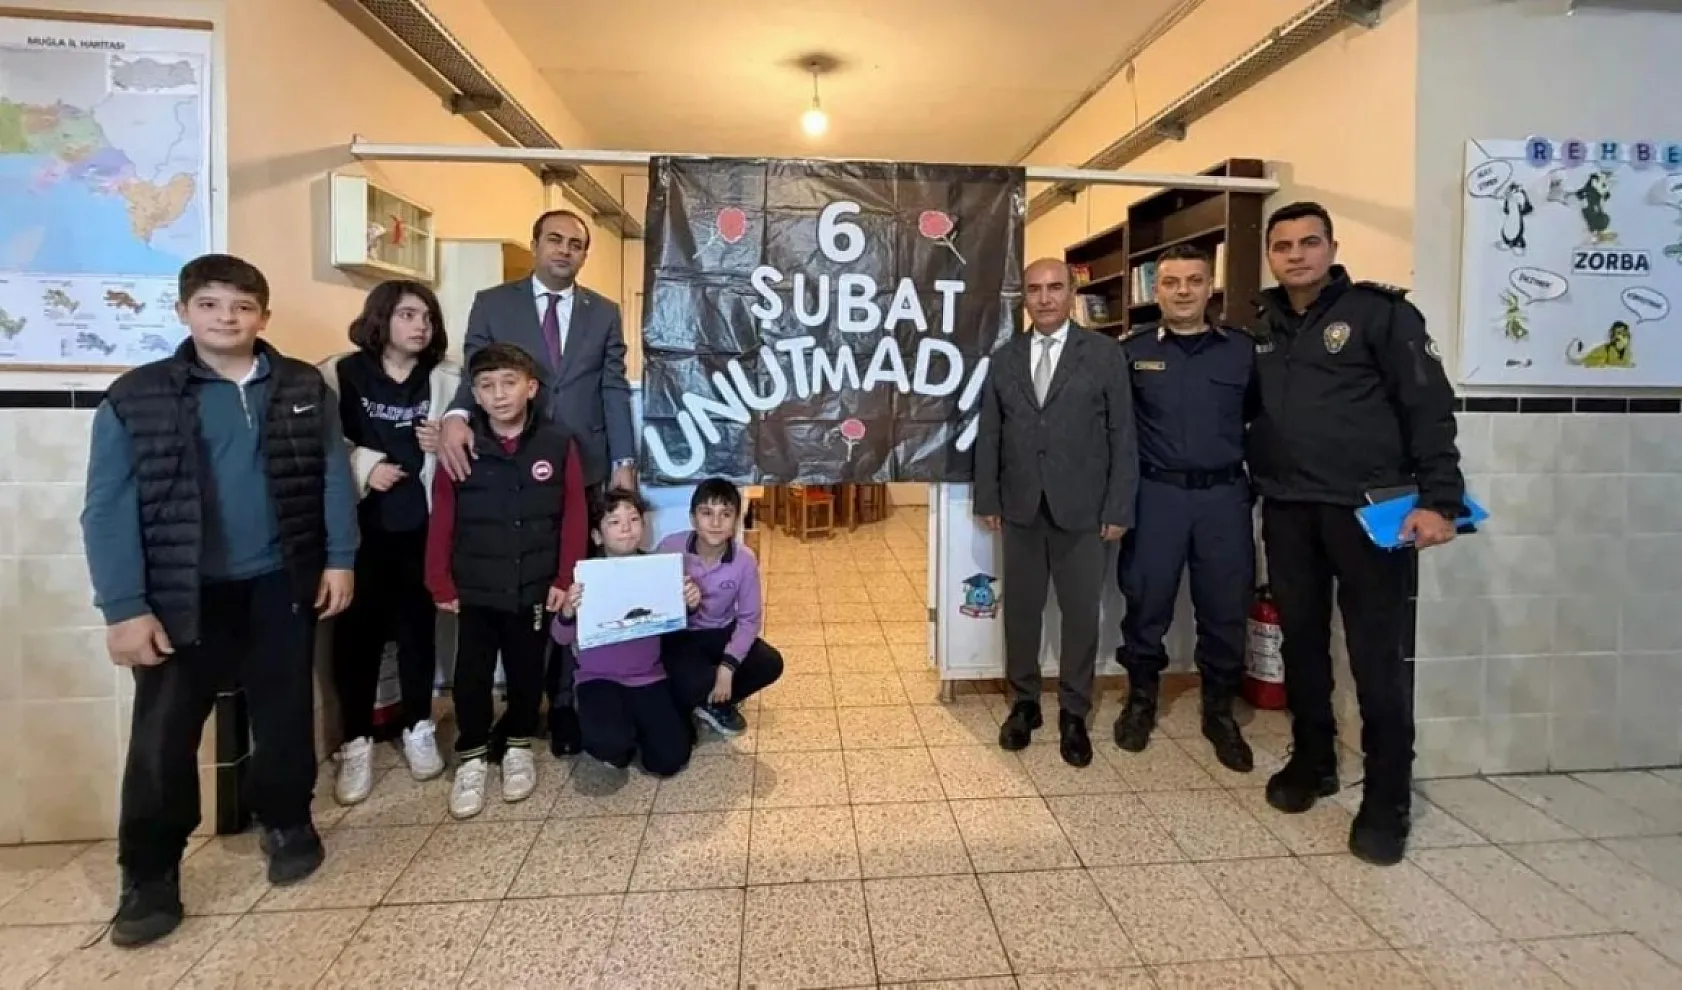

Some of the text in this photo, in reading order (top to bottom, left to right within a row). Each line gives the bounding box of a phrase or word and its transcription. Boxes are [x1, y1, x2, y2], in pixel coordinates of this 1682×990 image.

[818, 201, 866, 263] 6
[1574, 252, 1649, 271] ZORBA
[750, 265, 966, 334] ŞUBAT
[645, 335, 990, 479] UNUTMADI
